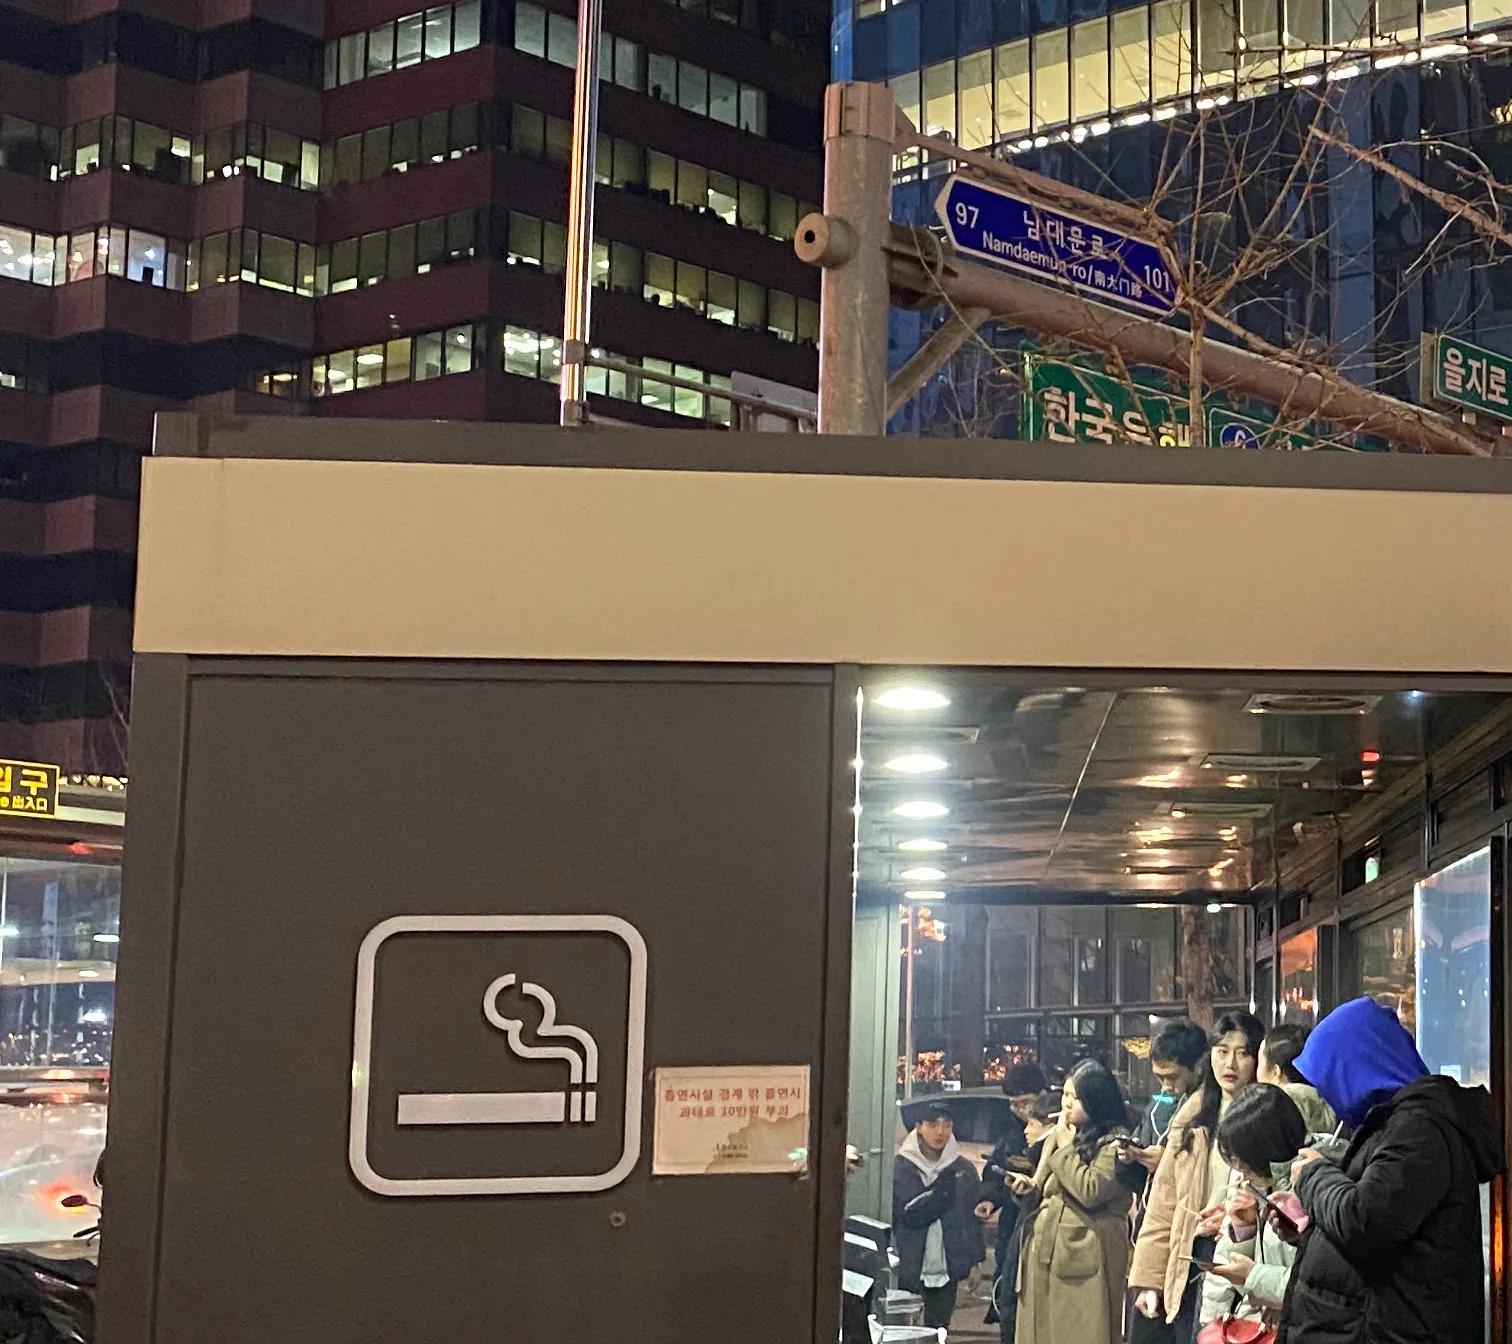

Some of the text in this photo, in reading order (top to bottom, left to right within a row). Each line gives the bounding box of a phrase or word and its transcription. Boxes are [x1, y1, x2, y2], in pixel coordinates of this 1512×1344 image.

[955, 202, 979, 229] 97
[1023, 210, 1111, 260] 남대문로
[1144, 264, 1171, 293] 101
